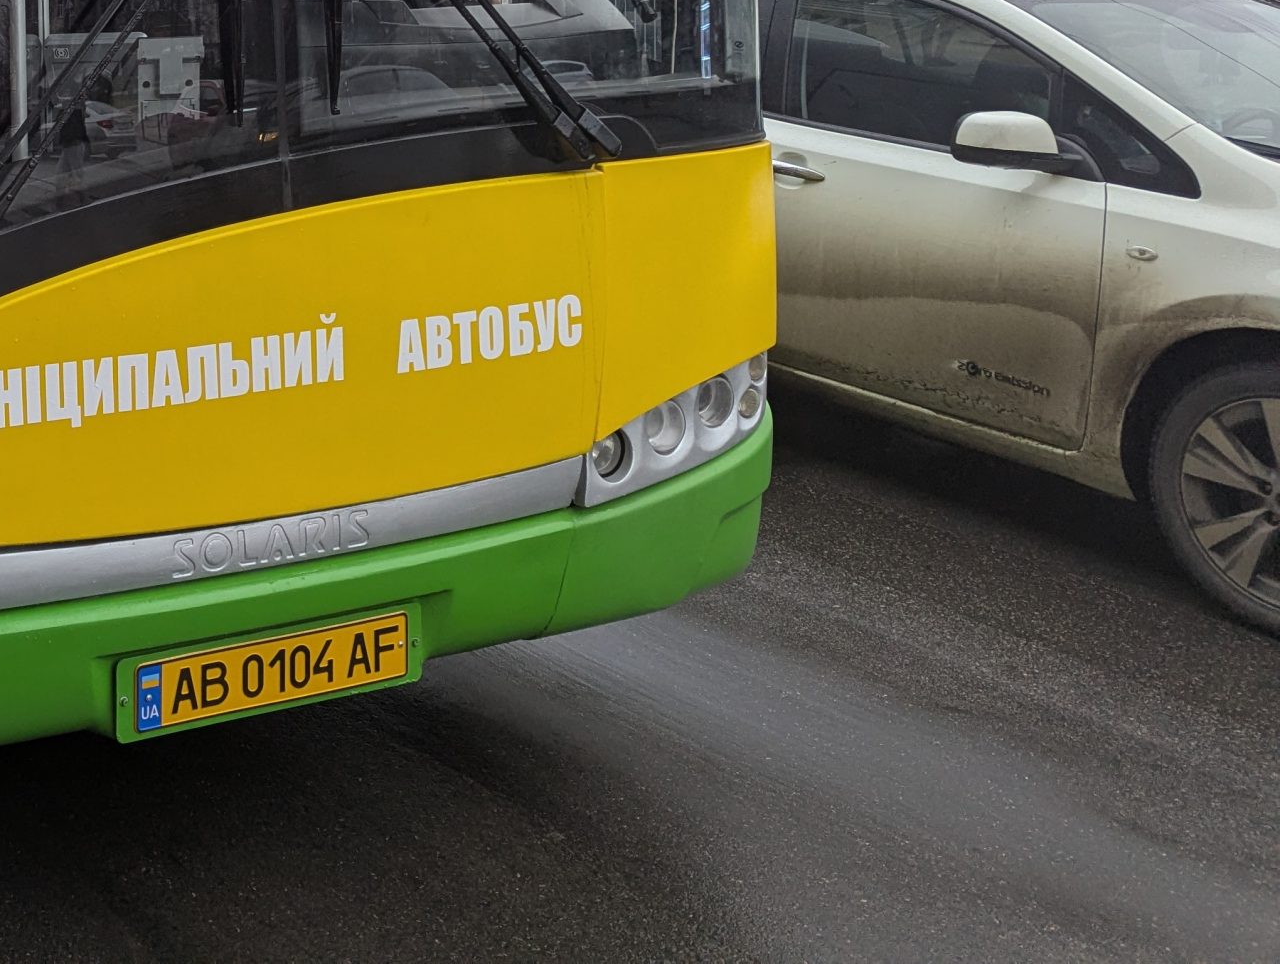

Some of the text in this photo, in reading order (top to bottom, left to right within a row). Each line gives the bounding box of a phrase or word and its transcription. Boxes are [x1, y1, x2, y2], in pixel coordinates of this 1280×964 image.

[396, 294, 583, 375] АВТОБУС
[172, 509, 371, 579] SOLARIS
[171, 624, 400, 715] AB 0104 AF
[141, 704, 160, 720] UA
